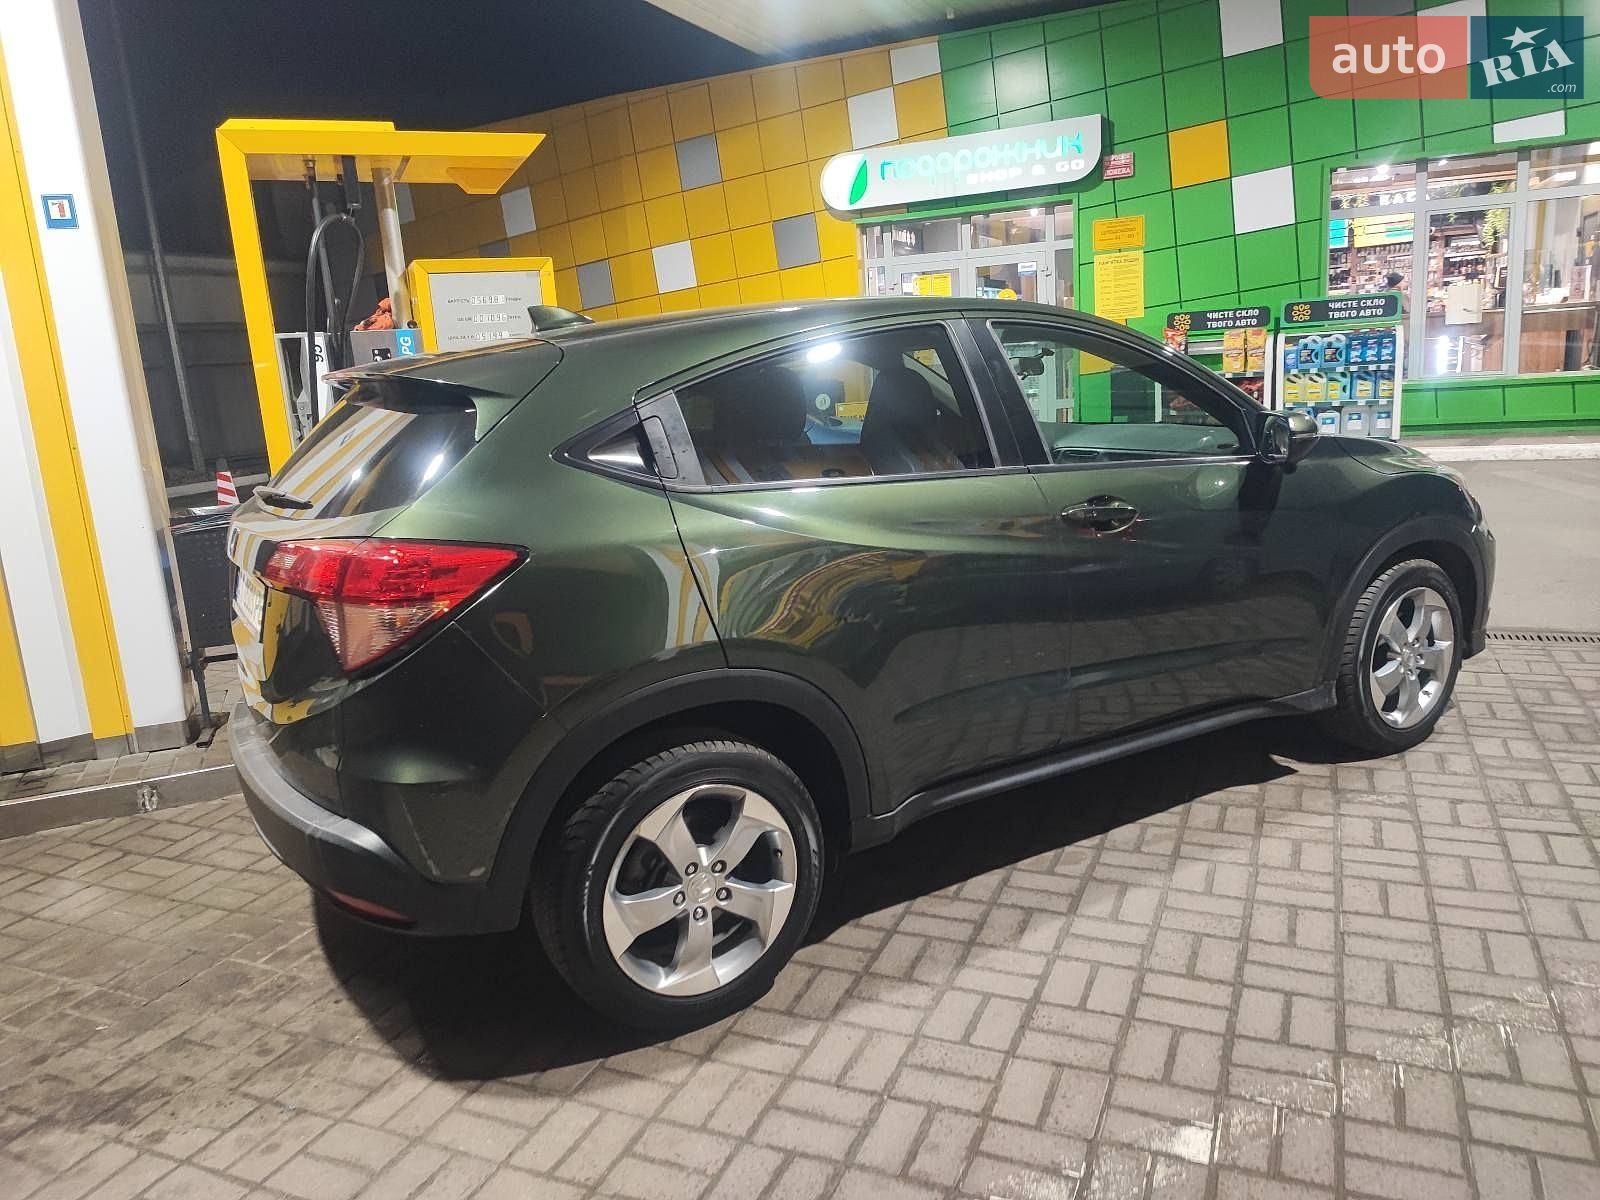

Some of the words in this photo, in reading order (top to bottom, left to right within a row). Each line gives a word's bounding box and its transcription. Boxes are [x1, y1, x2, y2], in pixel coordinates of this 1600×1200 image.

[1328, 300, 1358, 309] ЧИСТЕ
[1360, 298, 1385, 308] СКЛО
[1207, 310, 1234, 319] ЧИСТЕ
[1236, 308, 1259, 318] СКЛО
[1328, 310, 1357, 319] ТВОГО
[1358, 308, 1383, 317] АВТО
[1206, 319, 1233, 328] ТВОГО
[1234, 318, 1257, 327] АВТО
